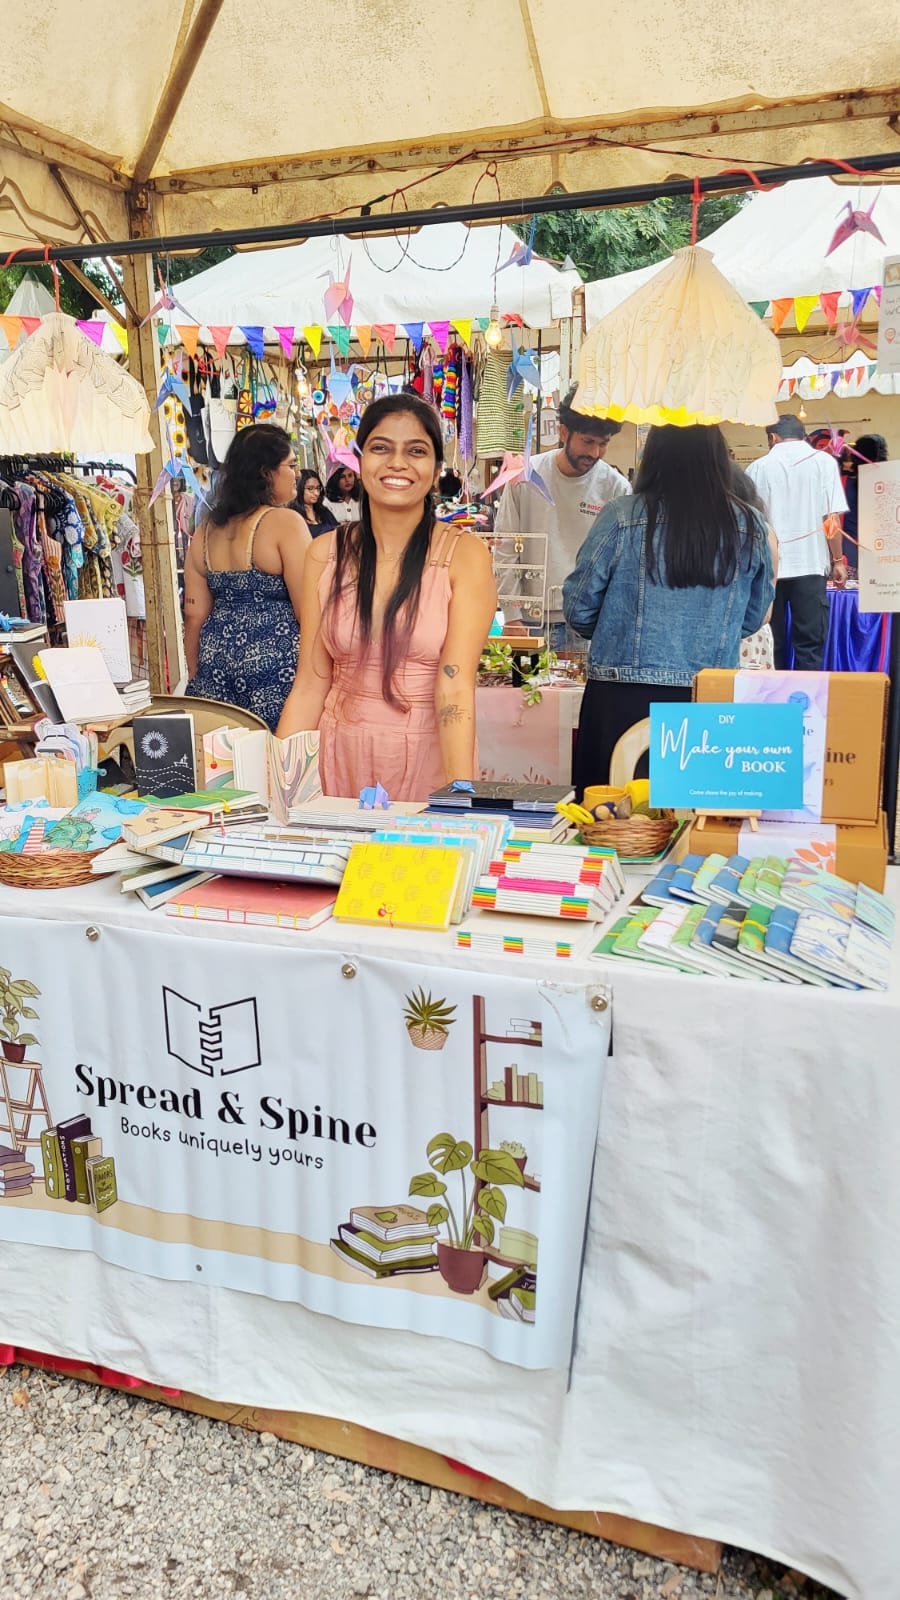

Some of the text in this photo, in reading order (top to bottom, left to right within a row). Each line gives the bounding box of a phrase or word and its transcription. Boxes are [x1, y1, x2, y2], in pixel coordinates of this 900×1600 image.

[587, 503, 602, 512] BOSC
[718, 714, 735, 725] DIY
[660, 717, 793, 771] Make your own
[826, 747, 857, 765] ine
[741, 760, 787, 774] BOOK
[75, 1063, 378, 1149] Spread & Spine
[120, 1116, 325, 1170] Books uniquely yours
